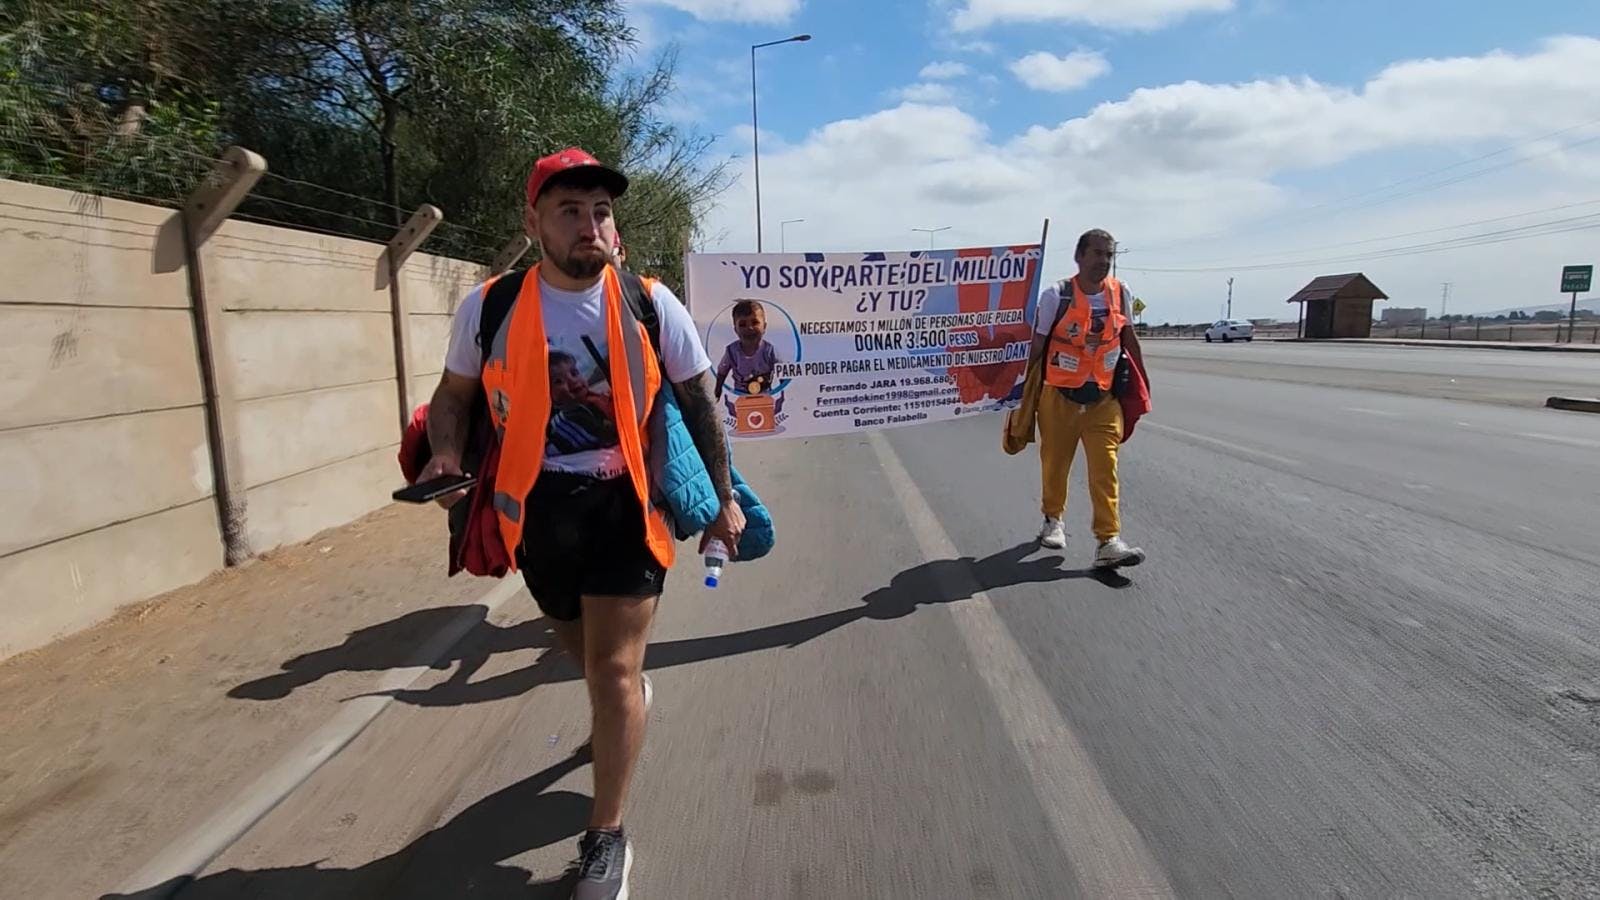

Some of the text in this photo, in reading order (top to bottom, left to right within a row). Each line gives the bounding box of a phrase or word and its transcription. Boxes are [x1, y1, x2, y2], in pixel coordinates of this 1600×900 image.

[779, 265, 824, 288] SOY
[831, 263, 899, 287] PARTE
[907, 262, 945, 284] DEL
[856, 289, 926, 313] ¿Y TU?
[800, 320, 867, 335] NECESITAMOS
[870, 321, 875, 331] 1
[915, 317, 927, 330] DE
[930, 313, 974, 329] PERSONAS
[976, 312, 992, 326] QUE
[995, 310, 1023, 324] PUEDA
[855, 330, 977, 352] DONAR 3.500 PESOS
[776, 363, 802, 378] PARA
[806, 362, 838, 376] PODER
[840, 360, 871, 374] PAGAR
[874, 358, 885, 371] EL
[888, 354, 951, 370] MEDICAMENTO
[955, 353, 966, 365] DE
[968, 350, 1003, 364] NUESTRO
[819, 382, 868, 393] Fernando
[871, 378, 897, 389] JARA
[813, 407, 850, 418] Cuenta
[853, 403, 901, 415] Corriente:
[854, 412, 927, 427] Banco Falabella
